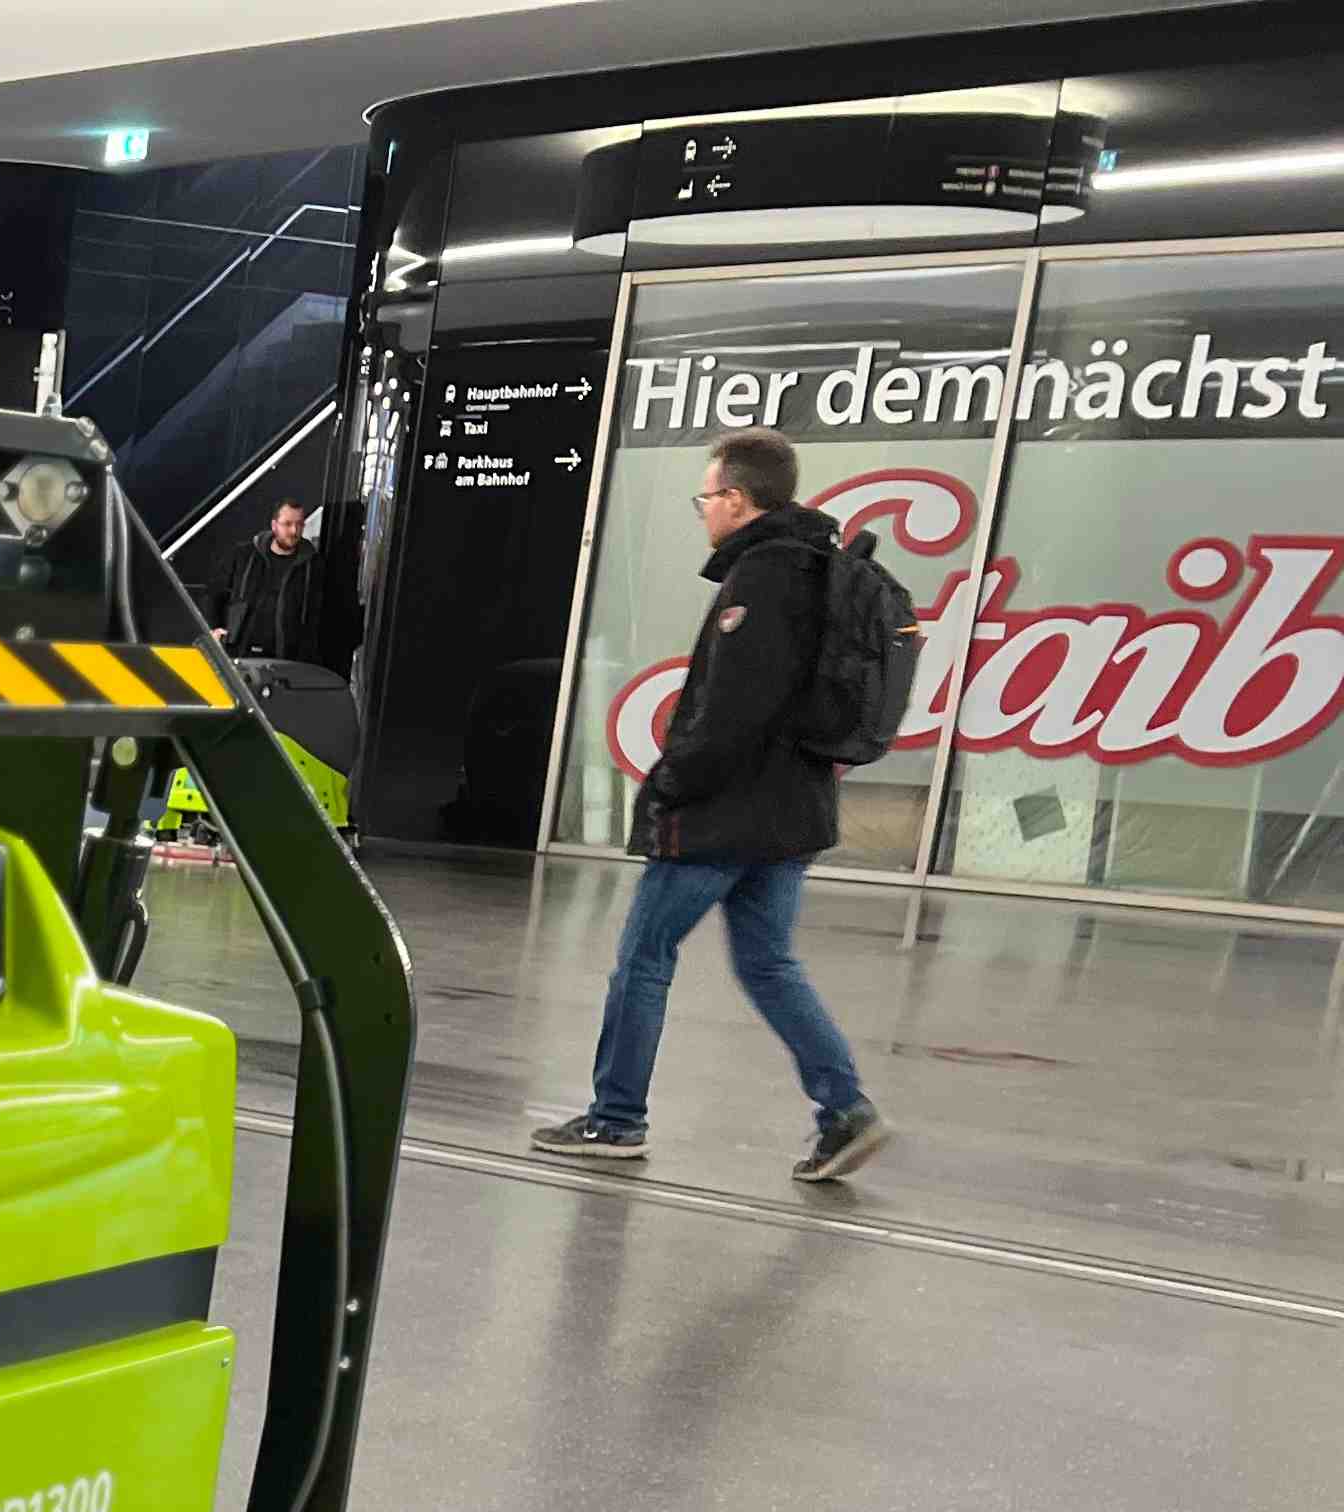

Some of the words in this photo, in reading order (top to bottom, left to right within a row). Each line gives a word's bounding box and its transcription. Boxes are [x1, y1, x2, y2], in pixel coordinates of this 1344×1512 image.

[630, 354, 799, 430] Hier
[817, 334, 1338, 427] demnächst
[466, 382, 559, 403] Hauptbahnhof
[463, 420, 489, 435] Taxi
[457, 455, 514, 469] Parkhaus
[455, 475, 475, 487] am
[477, 471, 531, 487] Bahnhof
